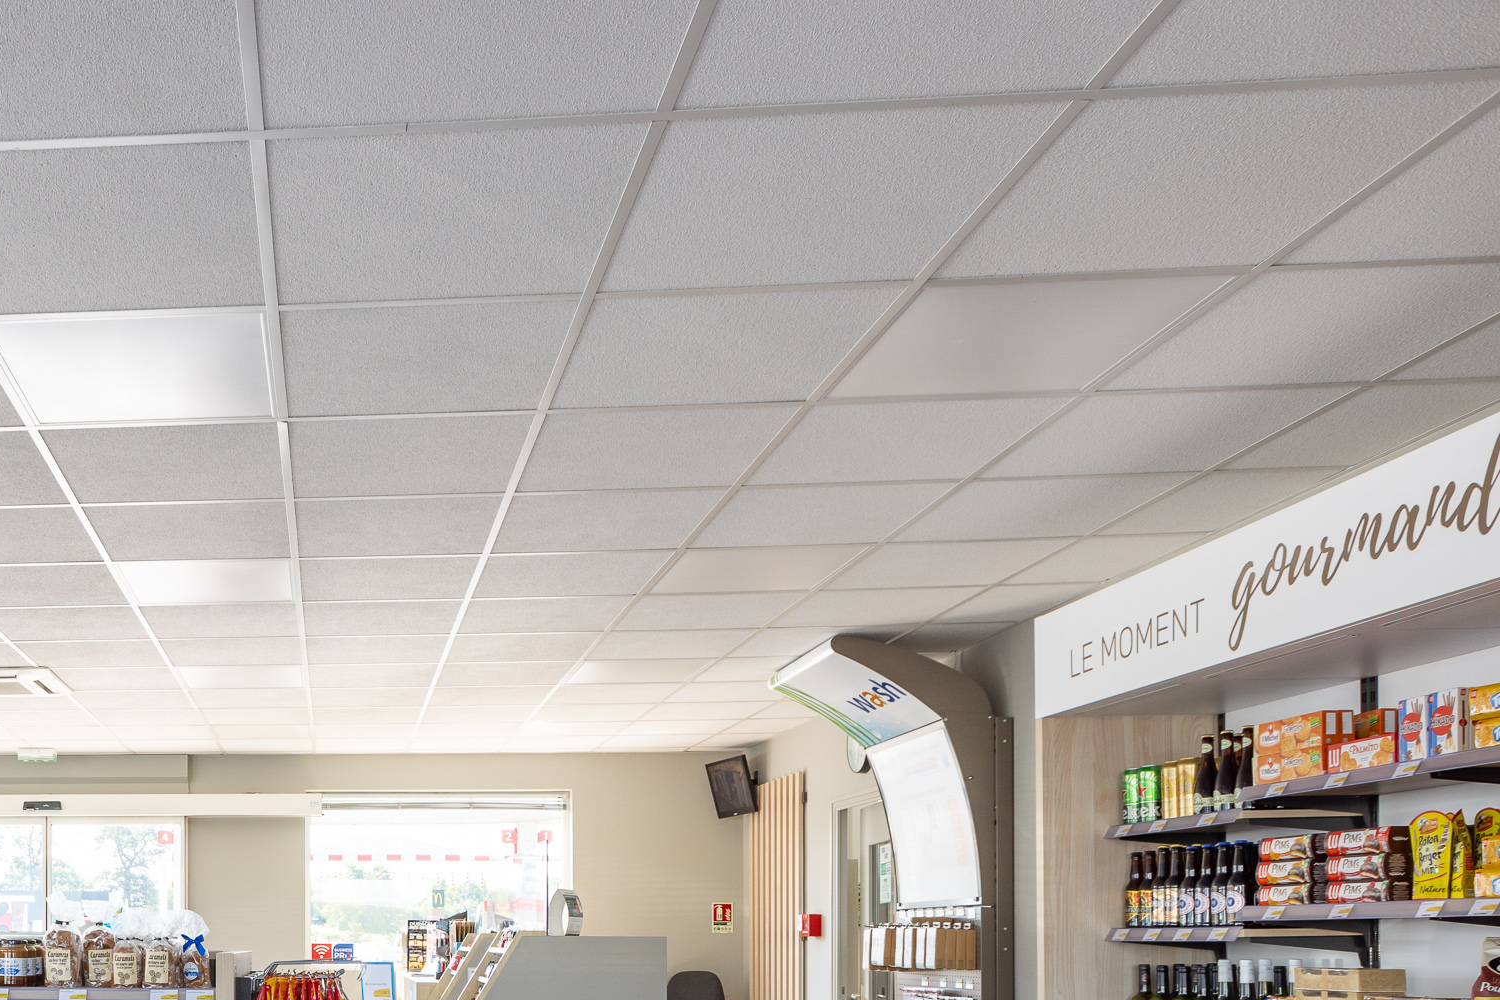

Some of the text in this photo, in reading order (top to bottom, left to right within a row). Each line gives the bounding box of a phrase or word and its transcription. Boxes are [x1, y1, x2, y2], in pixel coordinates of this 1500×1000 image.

[1070, 641, 1093, 678] LE
[1100, 598, 1205, 666] MOMENT
[847, 679, 907, 713] wash
[1283, 723, 1304, 733] Galettes
[1401, 722, 1423, 733] MIKADO
[1430, 714, 1455, 728] MIKADO
[1349, 742, 1379, 755] PALMITO
[1283, 756, 1304, 766] Galettes
[1328, 748, 1340, 768] LU
[1262, 842, 1271, 855] LU
[1328, 834, 1338, 849] LU
[1259, 864, 1268, 878] LU
[1328, 859, 1338, 874] LU
[1260, 887, 1270, 901] LU
[1328, 884, 1338, 899] LU
[1420, 885, 1446, 894] Nature
